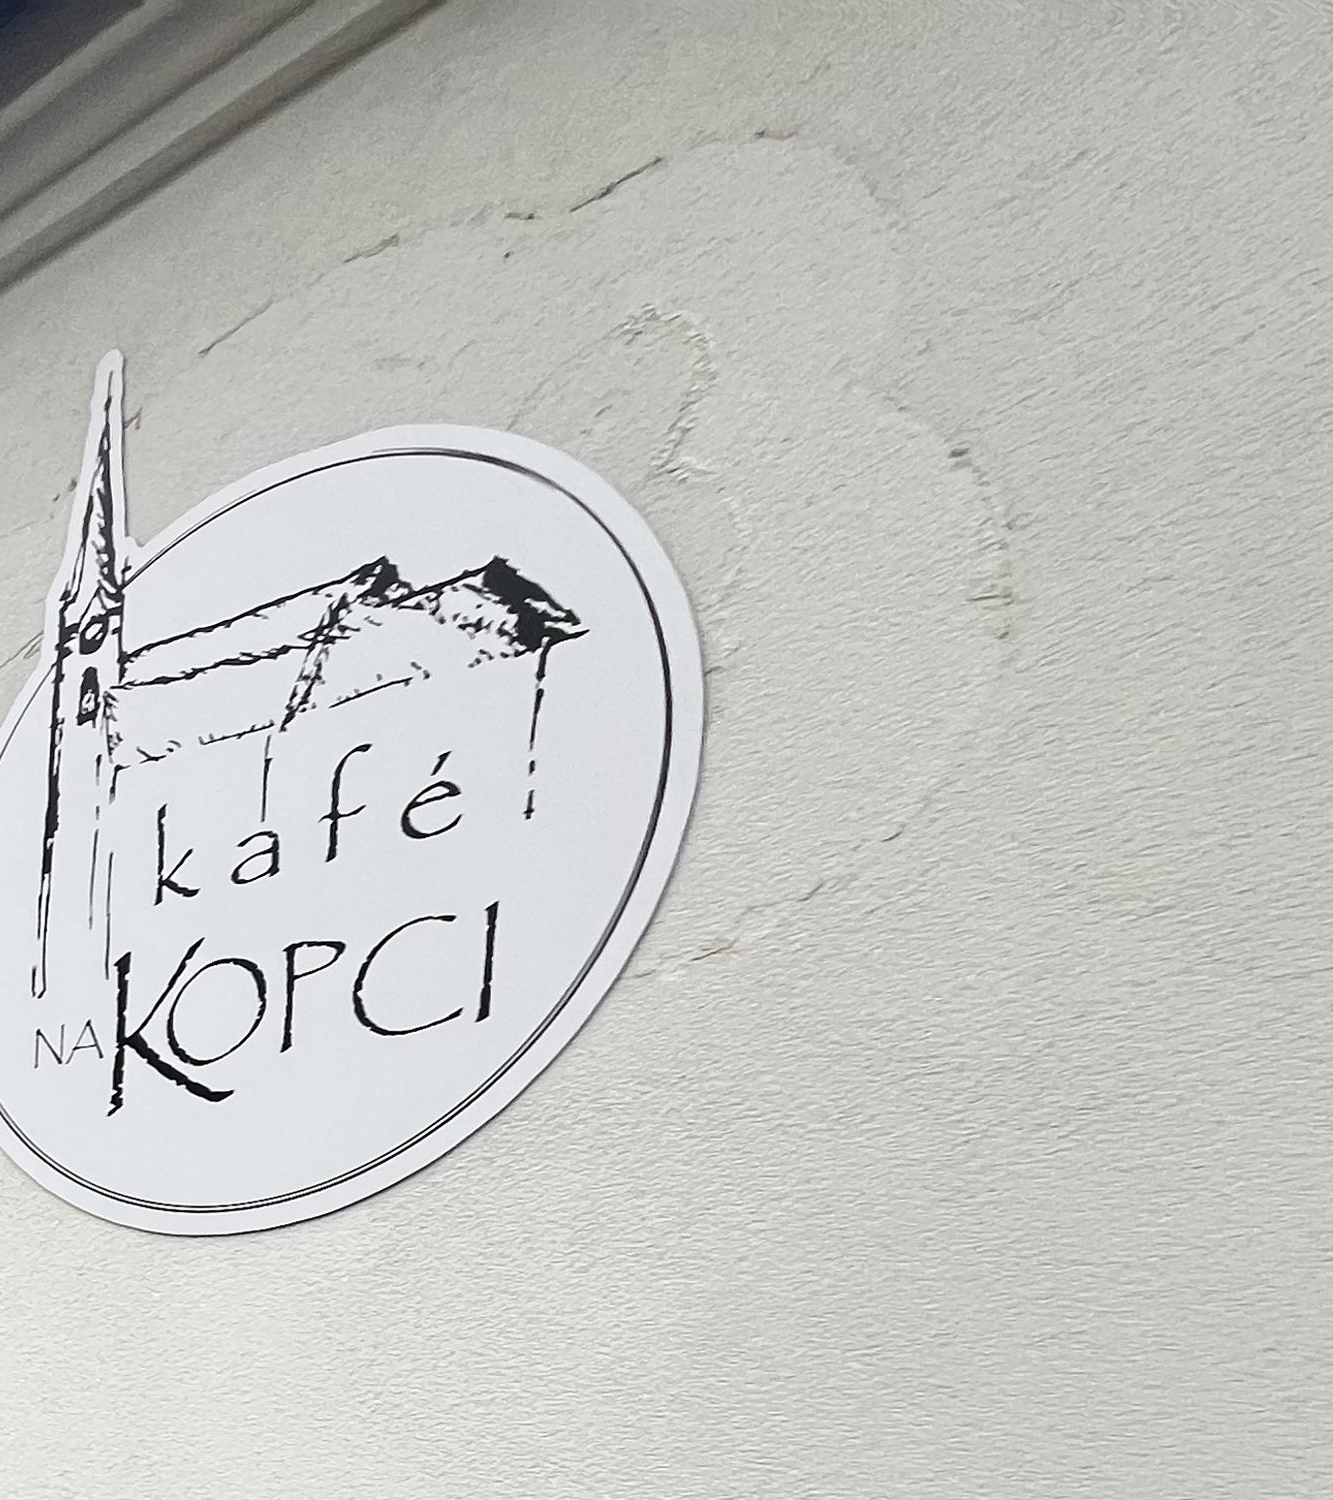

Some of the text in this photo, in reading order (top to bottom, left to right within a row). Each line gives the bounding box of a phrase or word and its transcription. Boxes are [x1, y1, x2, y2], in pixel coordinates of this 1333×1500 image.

[153, 743, 463, 906] kafé
[34, 900, 500, 1117] NA KOPCI
